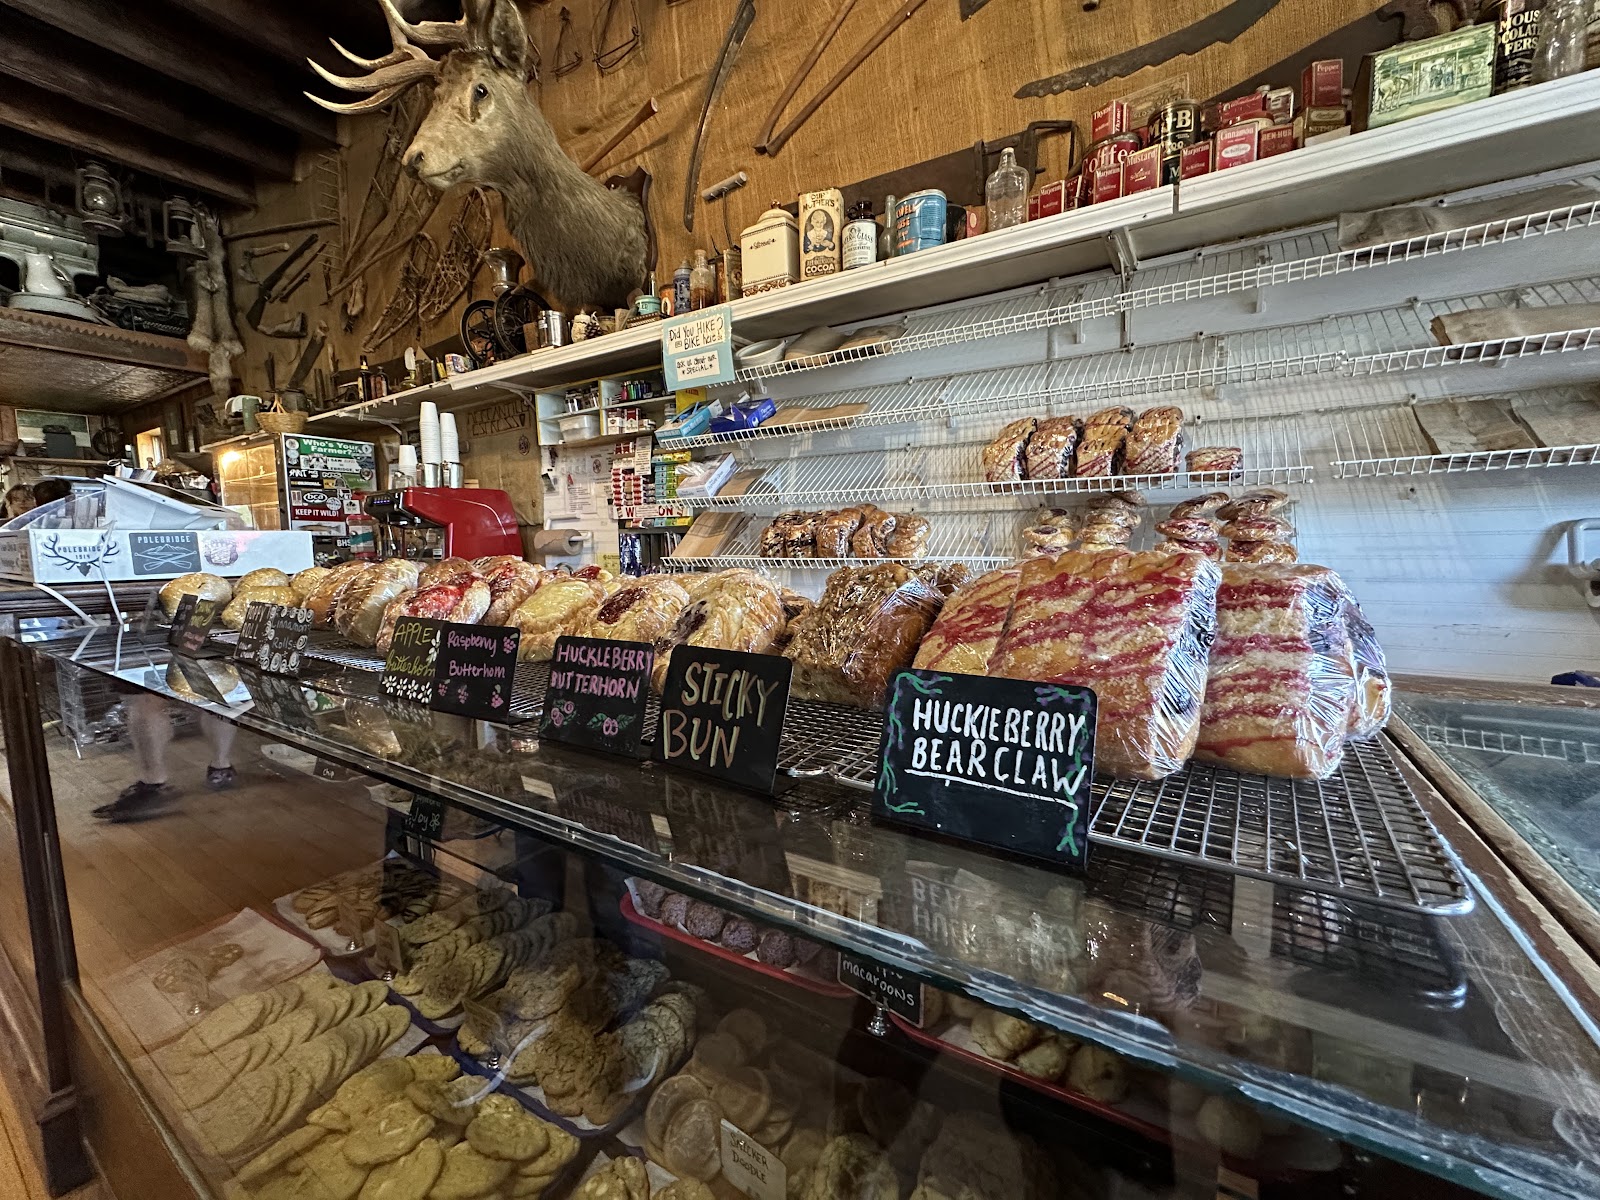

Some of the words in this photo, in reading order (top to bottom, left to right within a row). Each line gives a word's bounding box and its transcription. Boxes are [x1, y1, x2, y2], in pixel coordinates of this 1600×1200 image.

[1317, 62, 1340, 72] Pepper
[1093, 104, 1113, 121] Thyme
[1220, 127, 1254, 141] Cinnamon
[1182, 143, 1210, 157] Marjoram
[1126, 149, 1158, 168] Mustard
[1095, 167, 1121, 179] Marjoram
[1040, 184, 1062, 197] Marjoram
[805, 262, 836, 275] COCOA
[668, 326, 681, 342] Did
[682, 325, 695, 339] You
[696, 318, 716, 335] HIKE
[683, 335, 701, 350] BIKE
[302, 438, 335, 448] Who's
[336, 441, 359, 451] Your
[310, 445, 353, 455] Farmer?
[307, 491, 325, 500] bca
[294, 508, 313, 517] KEEP
[312, 508, 319, 517] IT
[319, 509, 339, 518] WILD!
[137, 534, 191, 544] POLEBRIDGE
[57, 545, 103, 554] POLEBRIDG
[393, 622, 434, 648] APPLE
[446, 630, 498, 658] Raspberry
[556, 643, 653, 677] HUCKLEBERRY
[448, 659, 507, 679] Butterhorn
[549, 670, 641, 703] BUTTERHORN
[680, 661, 780, 728] STICKY
[662, 708, 741, 769] BUN
[411, 806, 429, 832] Joy
